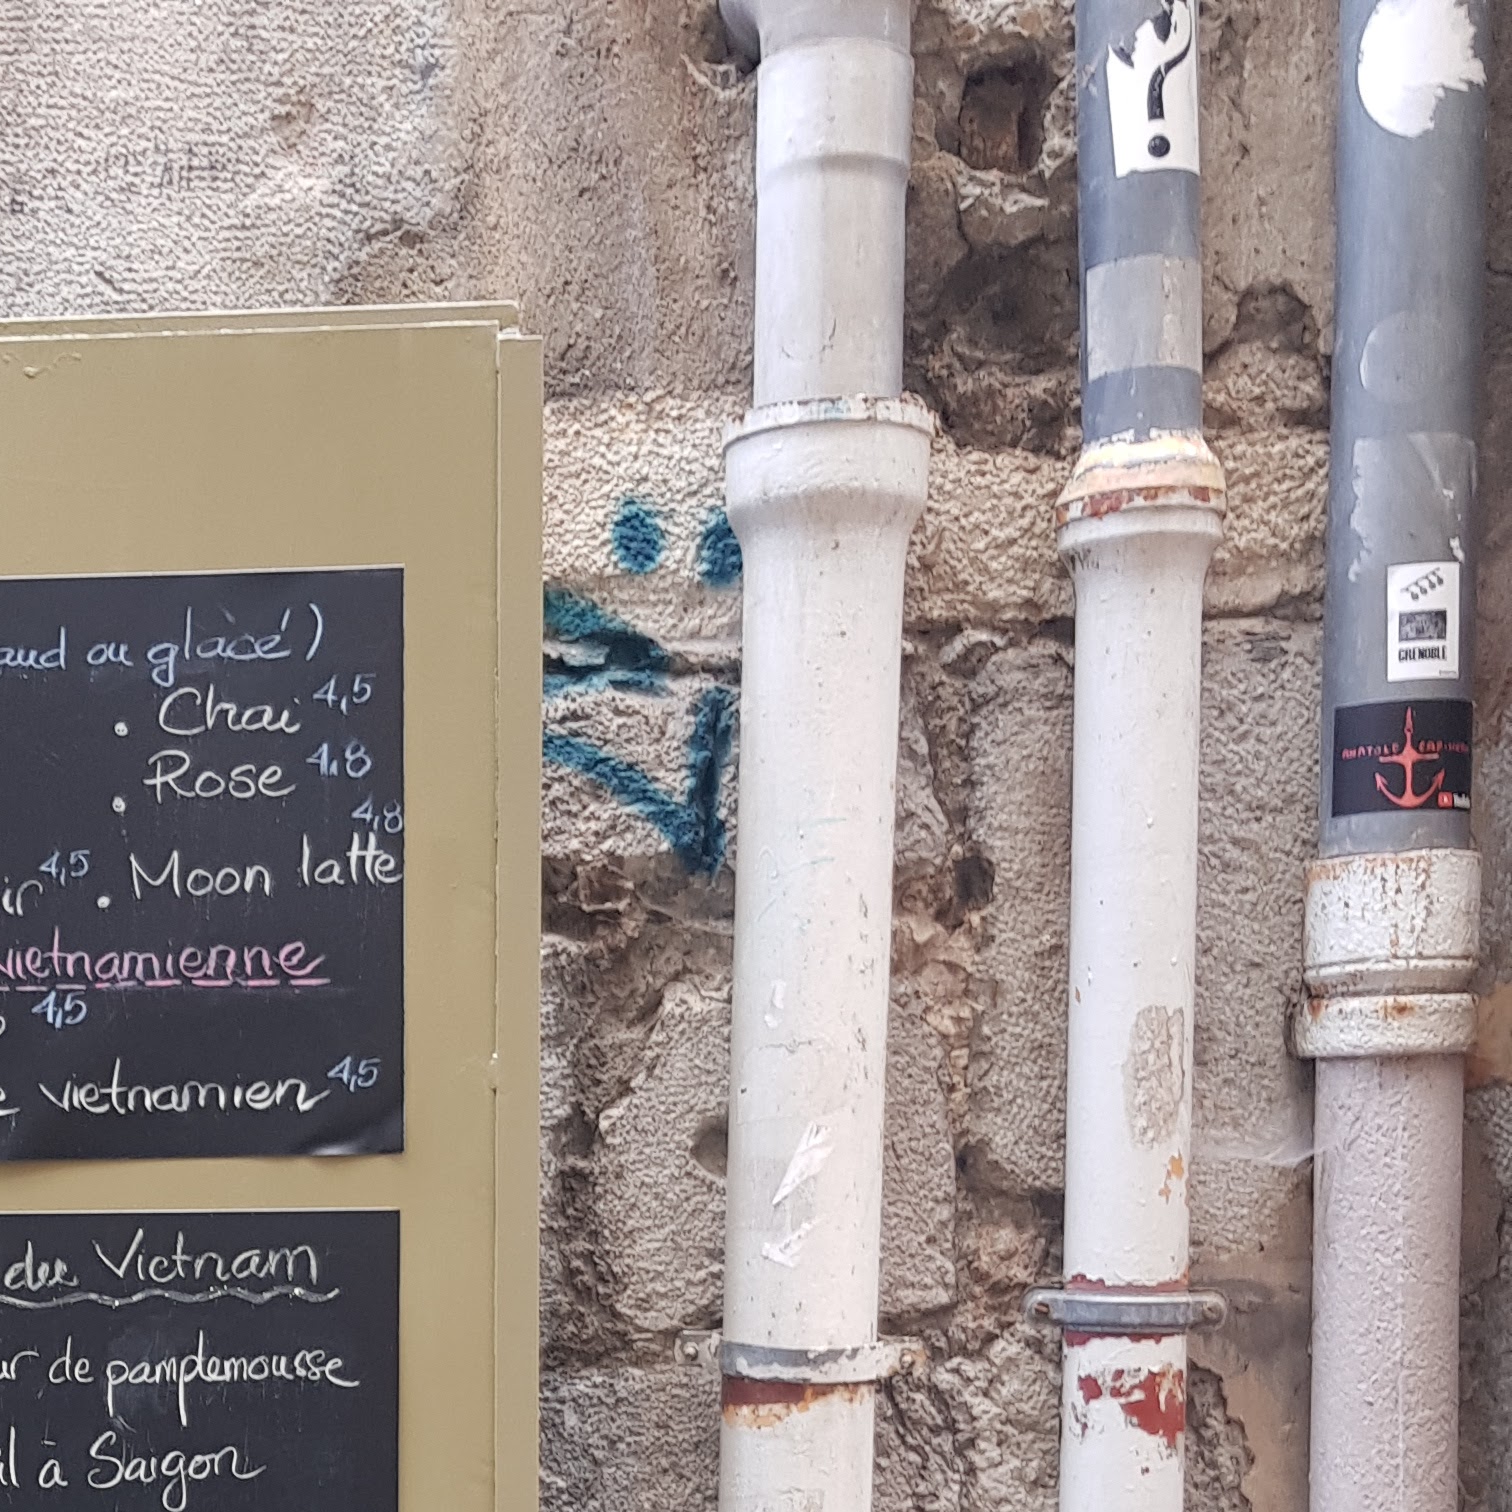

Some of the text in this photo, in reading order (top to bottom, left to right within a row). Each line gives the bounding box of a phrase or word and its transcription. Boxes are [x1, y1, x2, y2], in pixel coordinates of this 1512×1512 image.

[87, 644, 133, 667] ou
[159, 674, 375, 735] Chai 4,5
[143, 750, 296, 803] Rose
[39, 849, 90, 885] 4,5
[129, 795, 403, 899] Moon latte 4,8
[39, 1058, 333, 1113] vietnamien
[326, 1056, 381, 1090] 4,5
[92, 1228, 317, 1285] Vietnam
[48, 1337, 94, 1384] de
[106, 1329, 360, 1427] pamplemousse
[88, 1432, 268, 1510] Saigon
